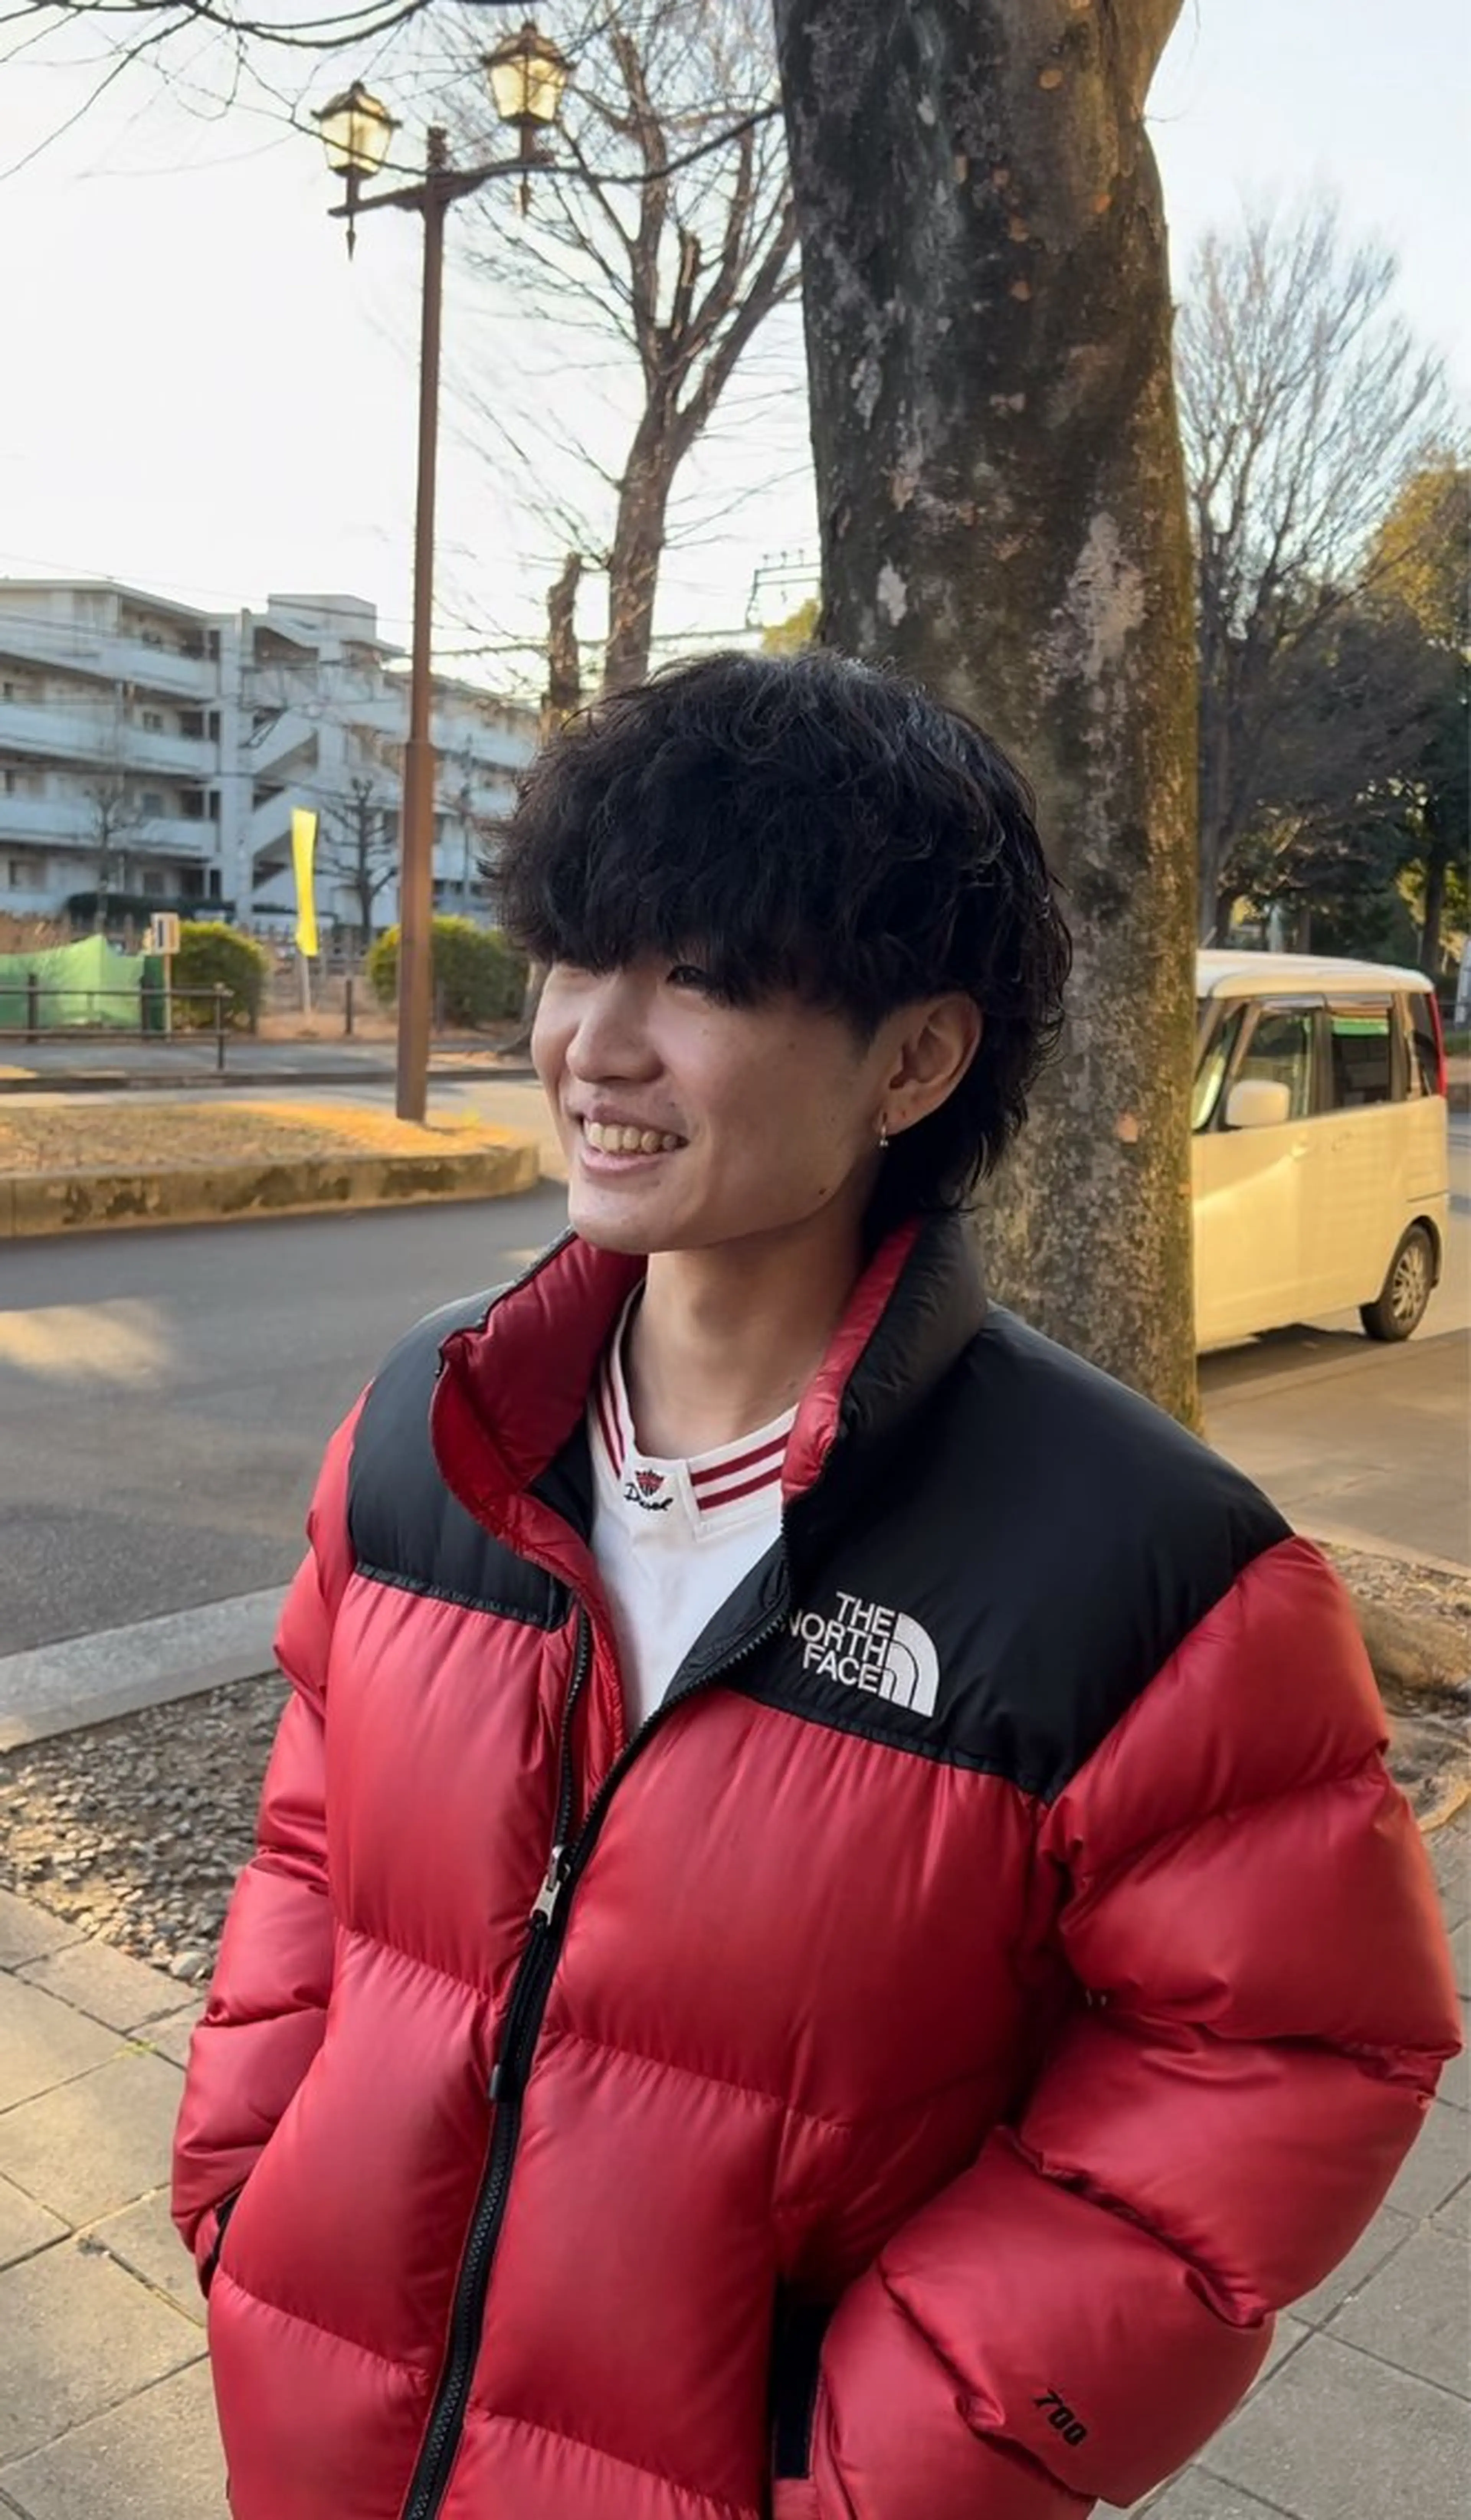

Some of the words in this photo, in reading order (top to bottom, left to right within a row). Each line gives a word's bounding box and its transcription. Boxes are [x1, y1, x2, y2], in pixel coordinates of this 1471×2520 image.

[836, 1590, 895, 1638] THE
[803, 1642, 881, 1693] FACE
[1034, 2388, 1087, 2446] 700
